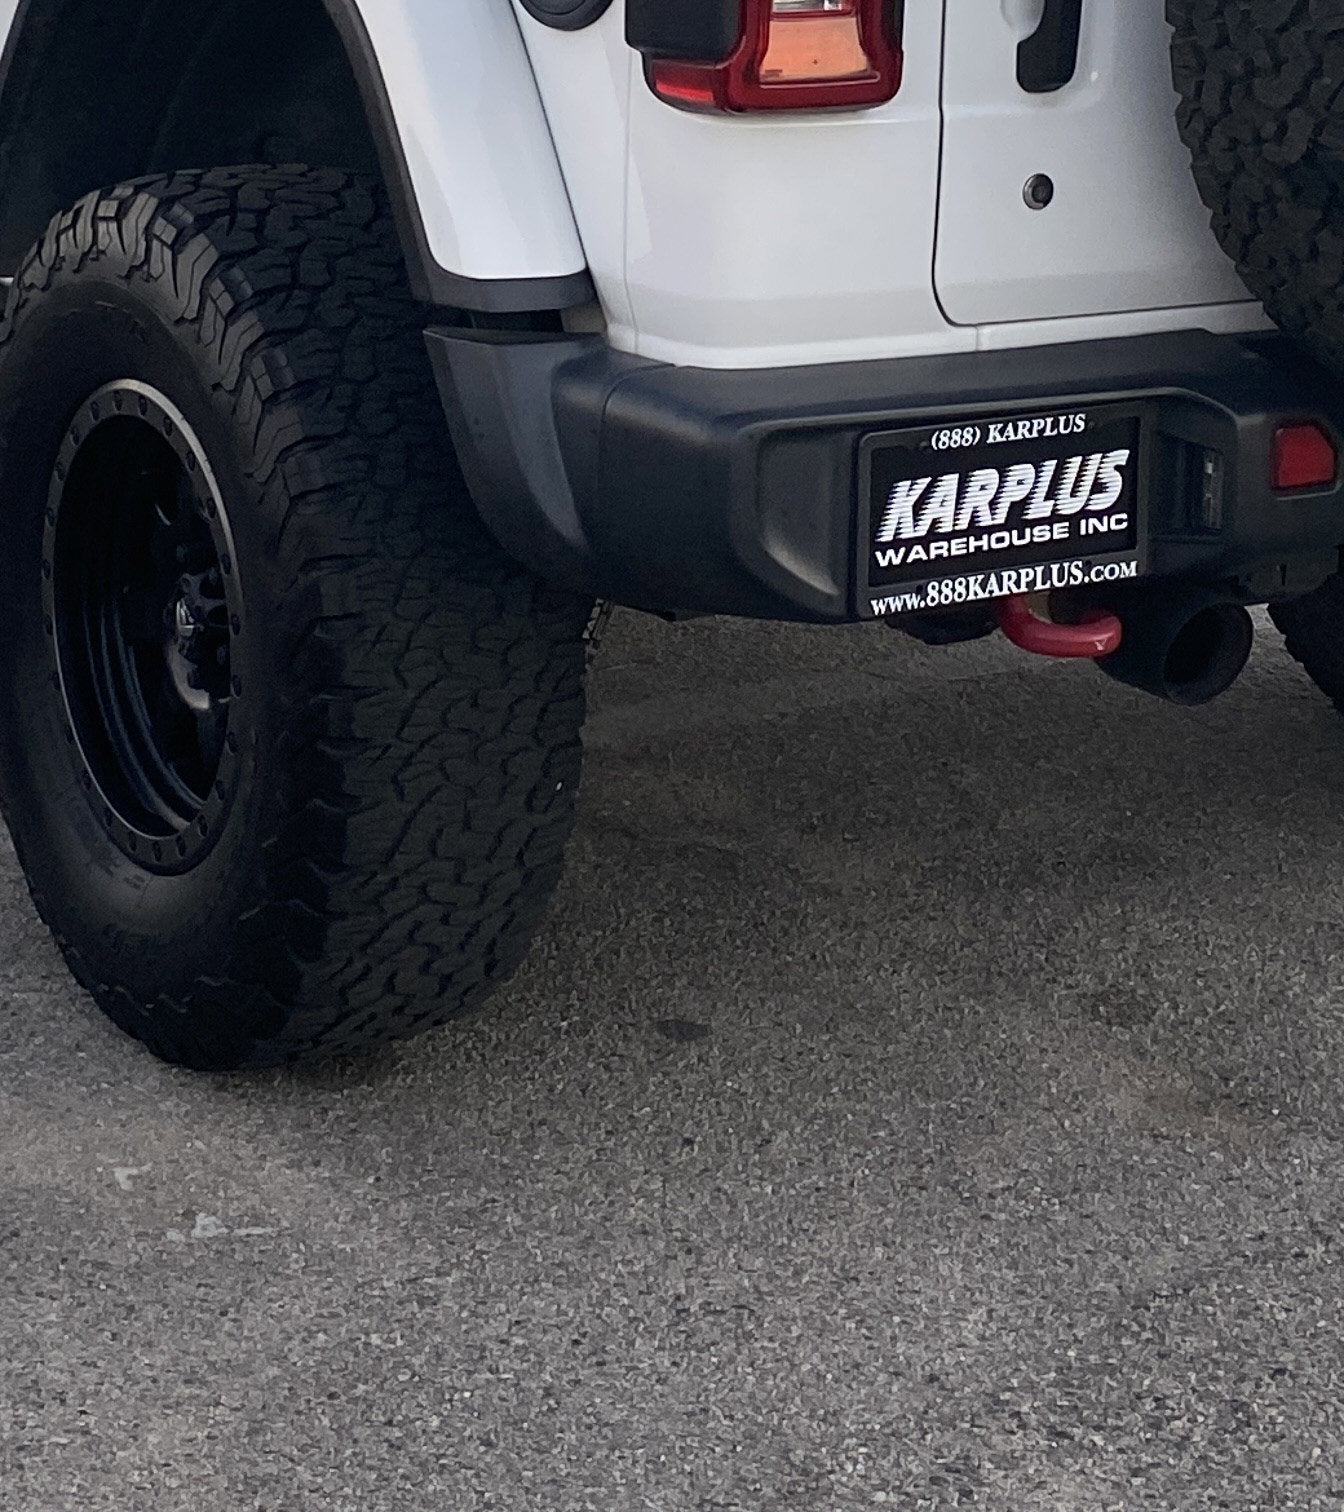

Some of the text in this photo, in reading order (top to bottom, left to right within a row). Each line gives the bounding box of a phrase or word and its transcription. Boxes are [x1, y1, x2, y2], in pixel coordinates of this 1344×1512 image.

[931, 413, 1086, 450] (888) KARPLUS
[874, 449, 1130, 543] KARPLUS
[875, 513, 1128, 567] WAREHOUSE INC
